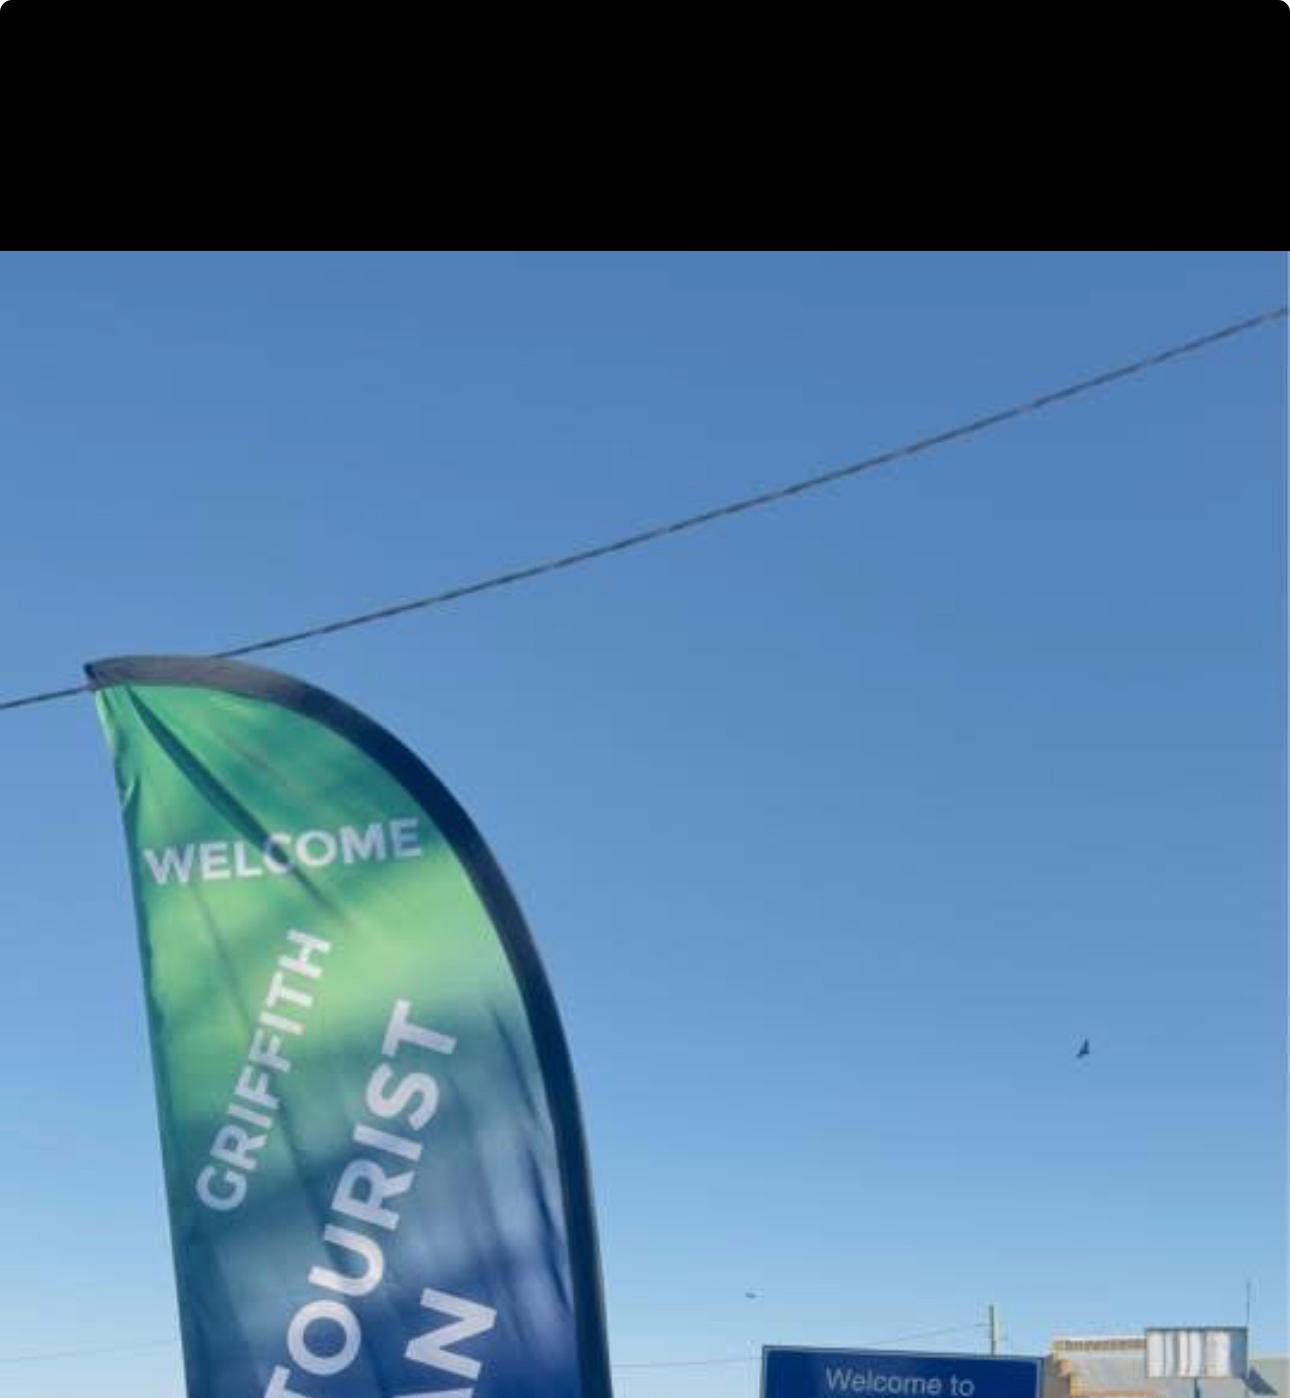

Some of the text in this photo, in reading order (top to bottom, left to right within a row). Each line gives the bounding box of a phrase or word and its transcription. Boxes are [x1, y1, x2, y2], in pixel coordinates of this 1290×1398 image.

[145, 818, 424, 885] WELCOME
[195, 929, 331, 1212] GRIFFITH
[827, 1368, 974, 1396] Welcome to
